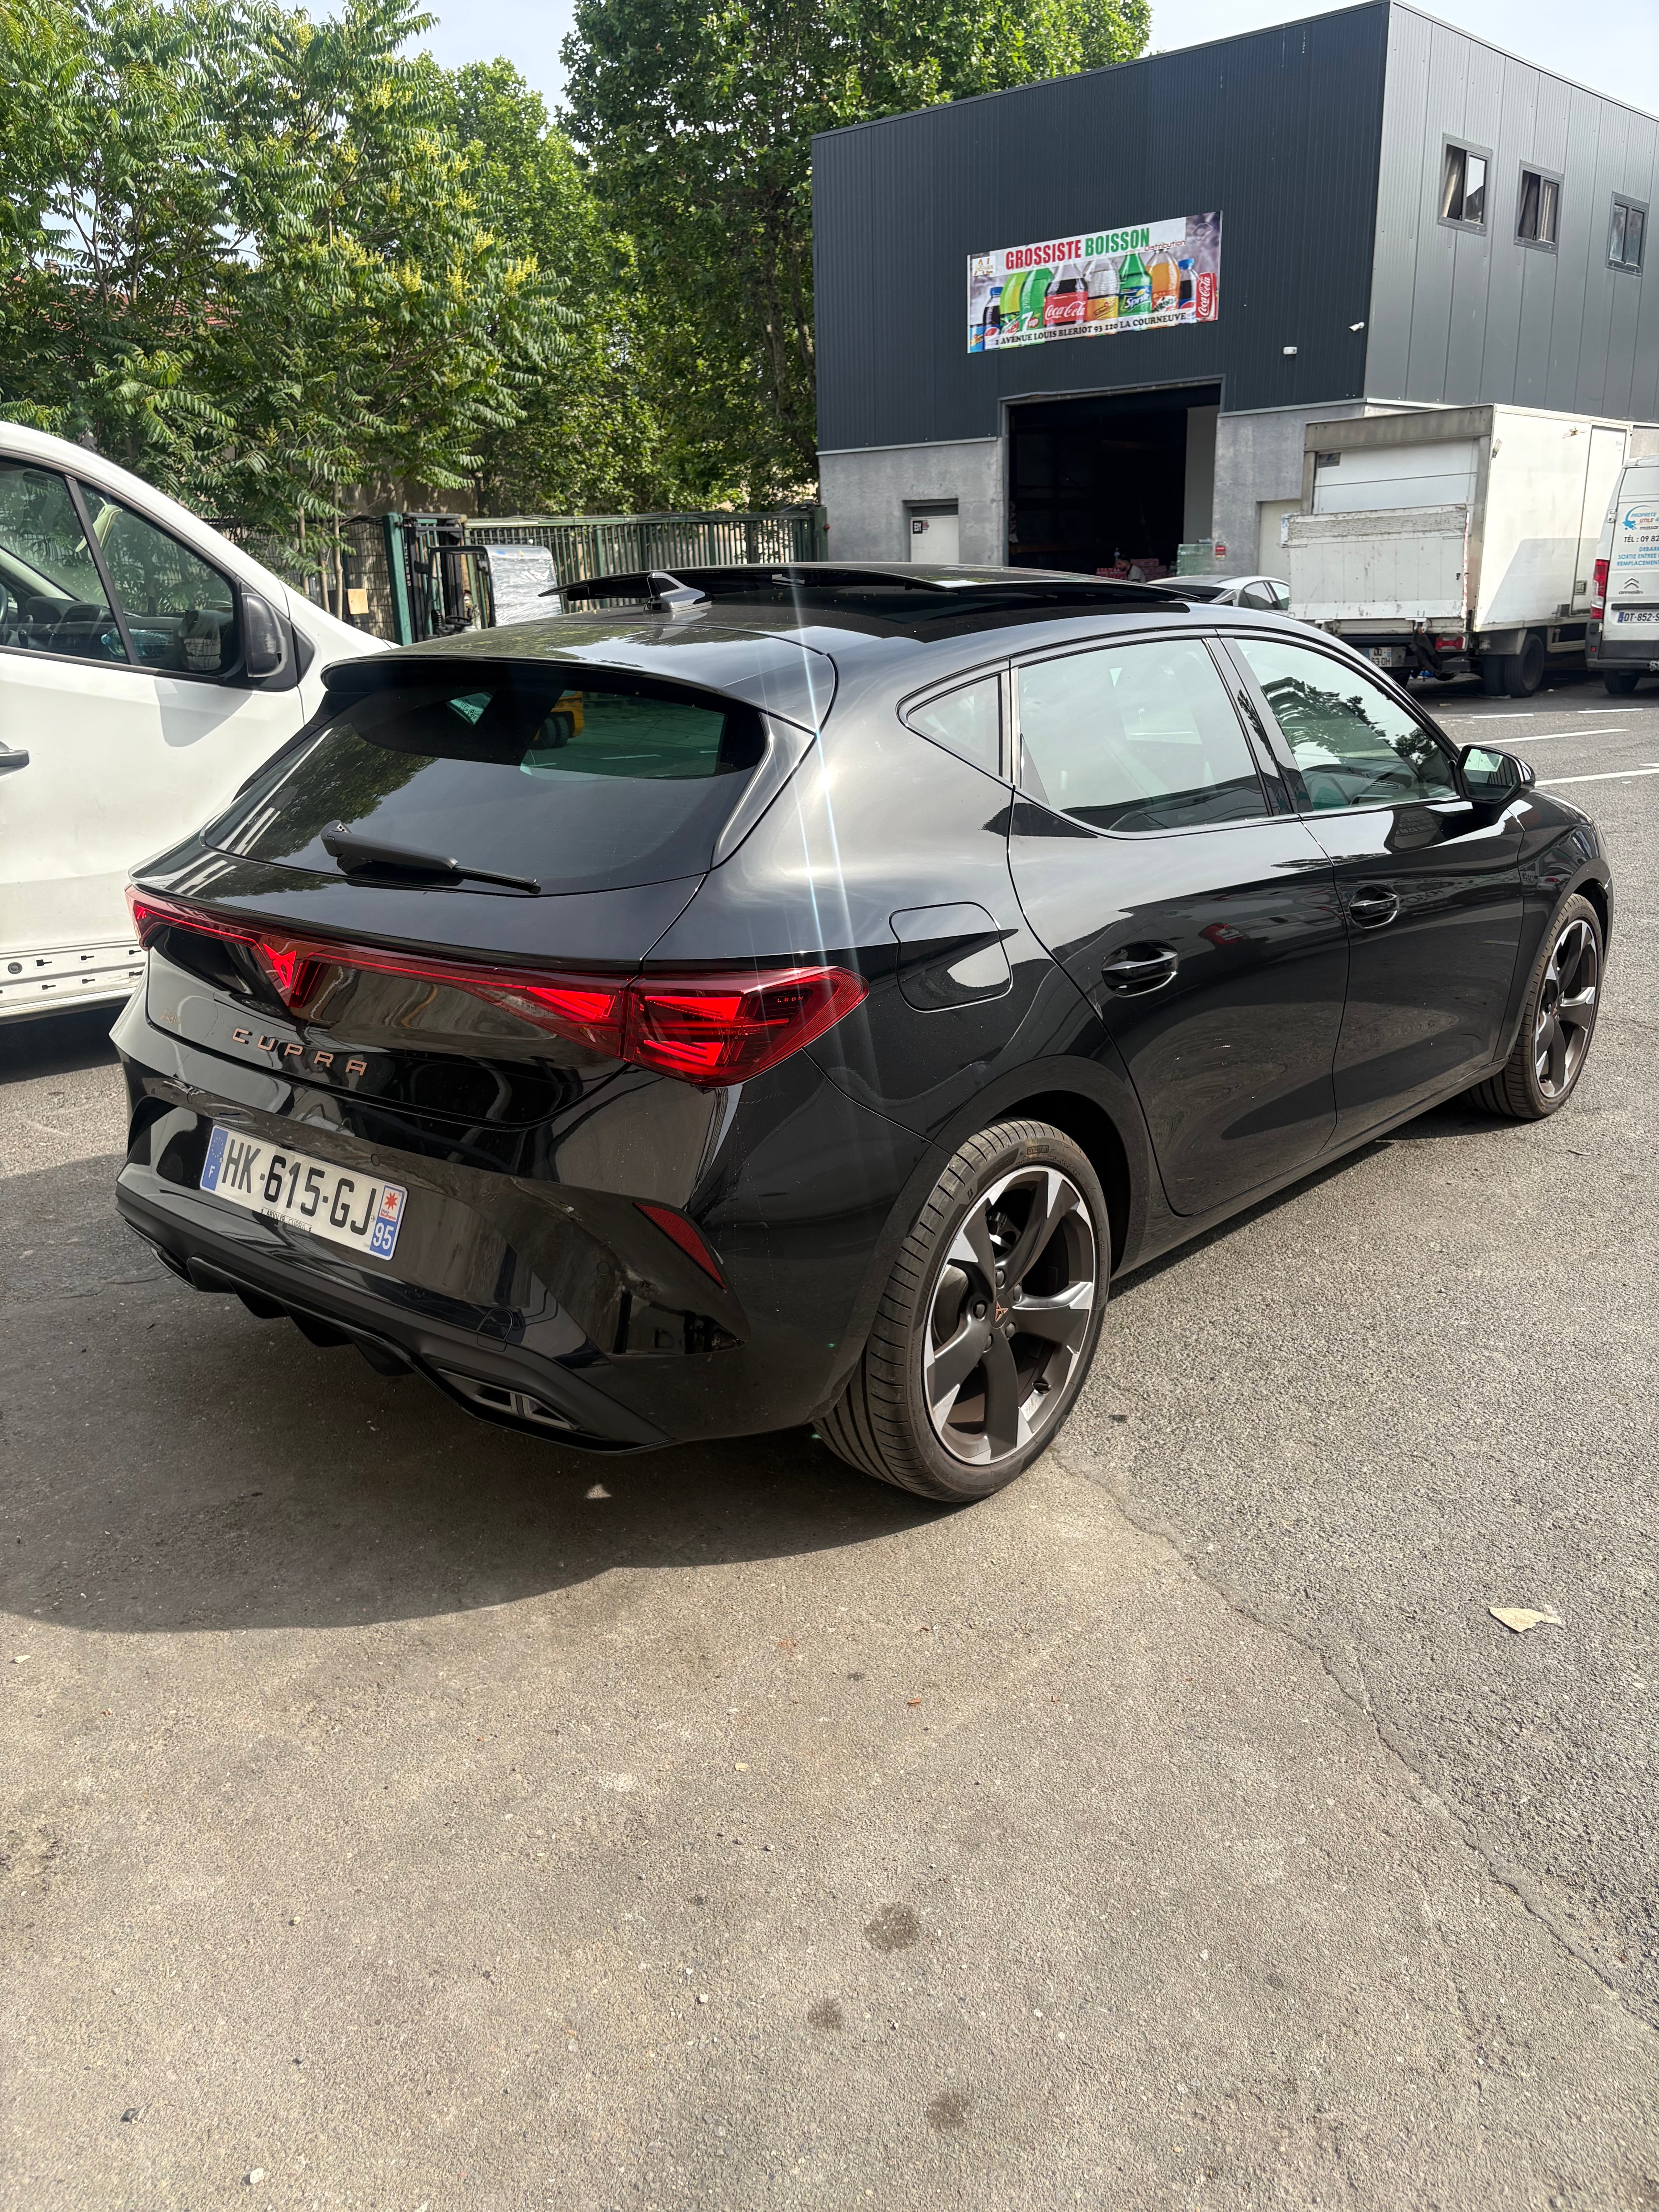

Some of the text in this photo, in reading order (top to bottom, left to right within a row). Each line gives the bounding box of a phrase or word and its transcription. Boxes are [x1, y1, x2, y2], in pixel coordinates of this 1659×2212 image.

[1006, 228, 1149, 270] GROSSISTE BOISSON
[1001, 334, 1032, 344] AVENUE
[1034, 331, 1057, 340] LOUIS
[1058, 326, 1093, 337] BLERIOT
[1133, 313, 1186, 326] COURNEUVE
[233, 1028, 367, 1076] CUPRA
[208, 1165, 215, 1178] F
[222, 1139, 376, 1236] HK-615-GJ
[373, 1222, 394, 1250] 95
